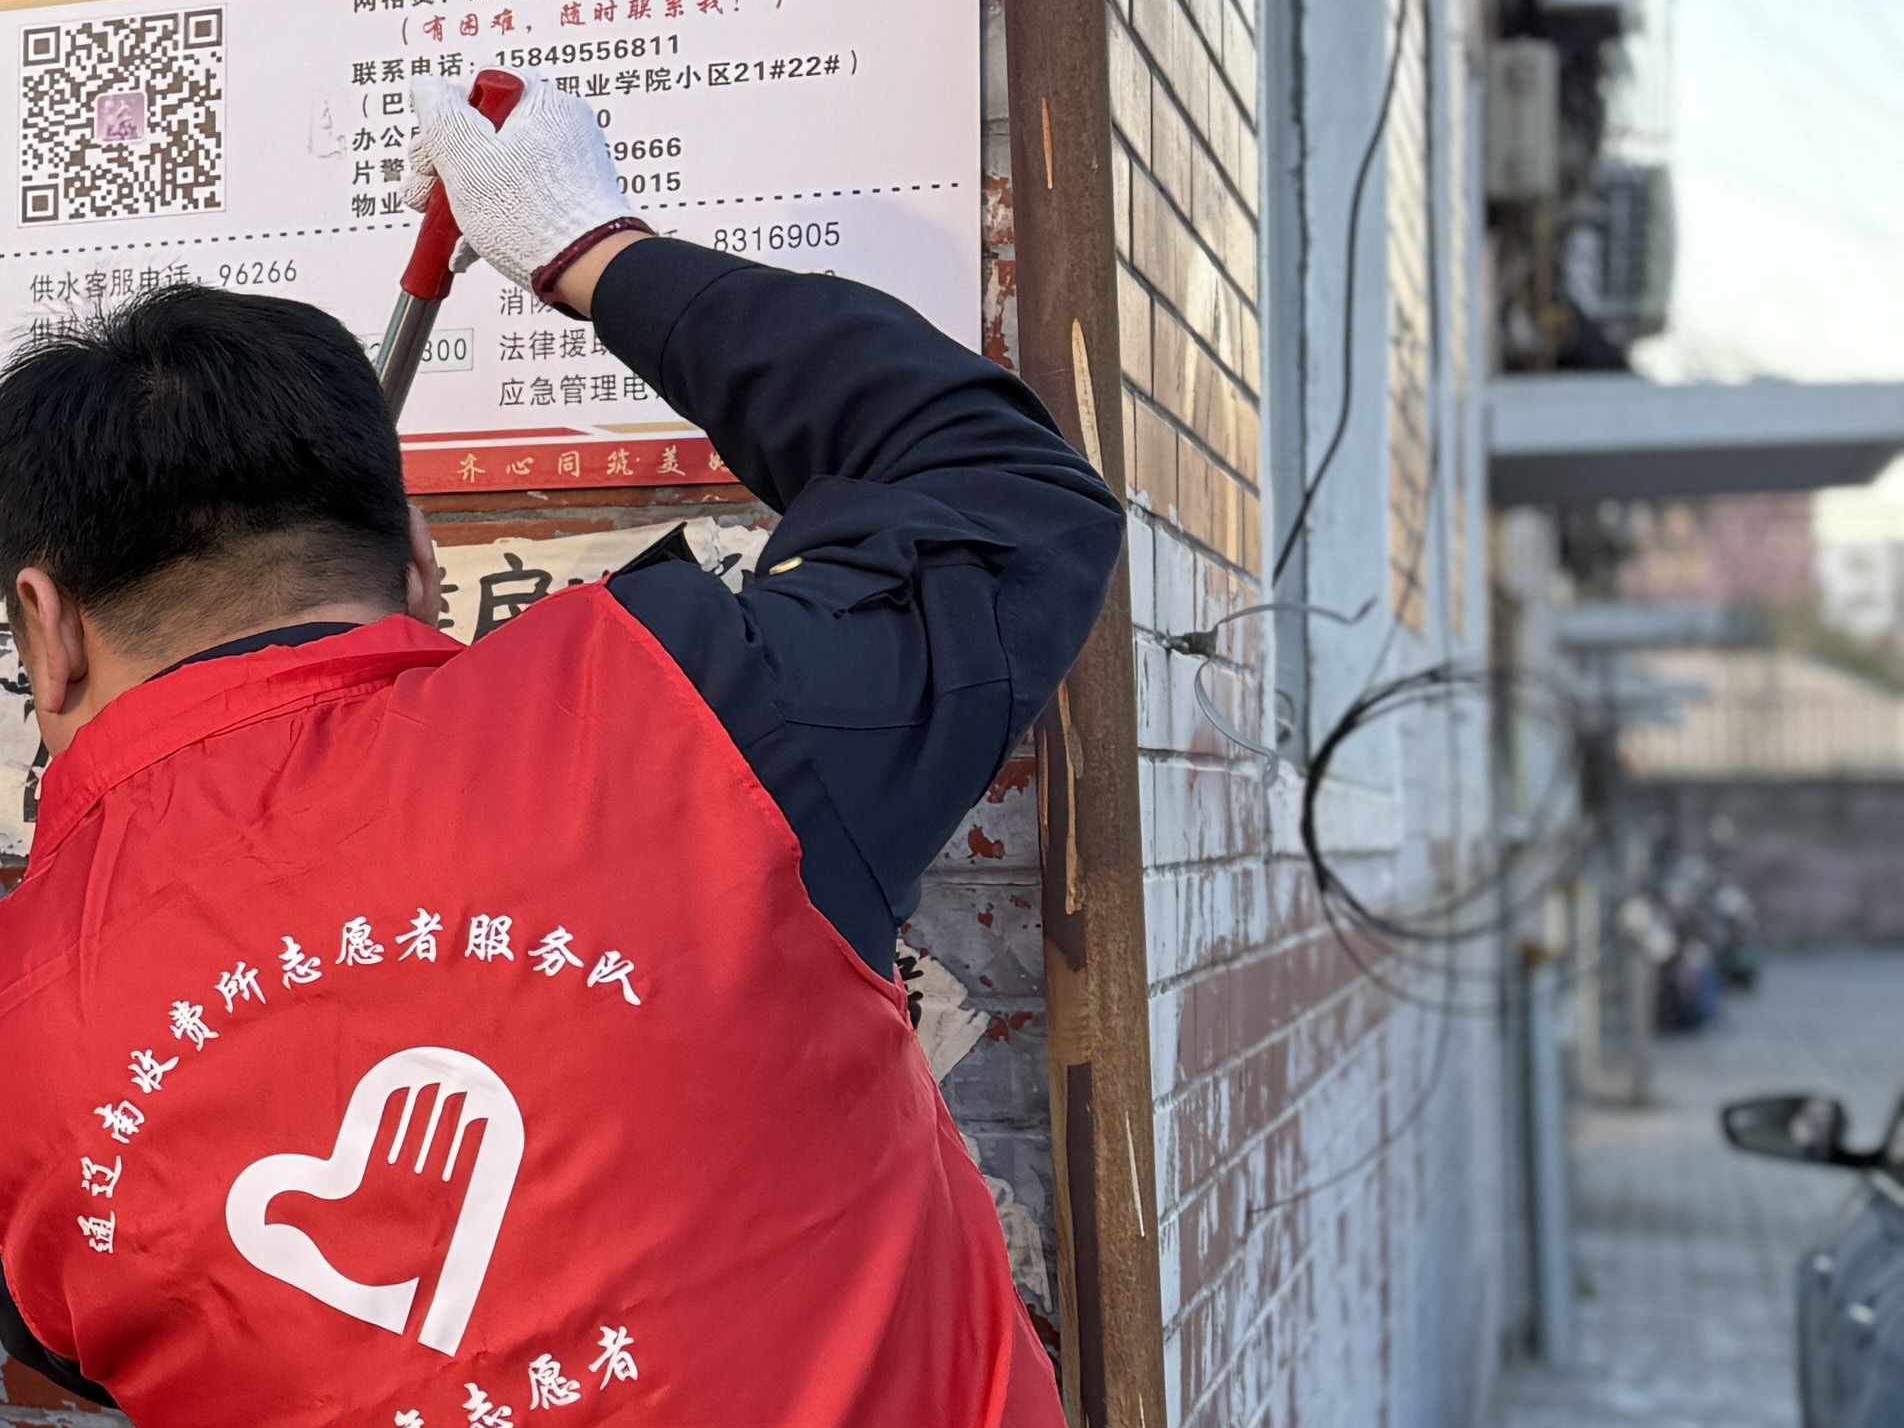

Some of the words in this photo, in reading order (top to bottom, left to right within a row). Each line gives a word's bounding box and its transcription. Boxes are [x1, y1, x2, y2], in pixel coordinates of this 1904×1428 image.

[714, 221, 841, 253] 8316905
[499, 372, 663, 407] 应急管理电
[78, 907, 642, 1254] 通辽南收费所志愿者服务队
